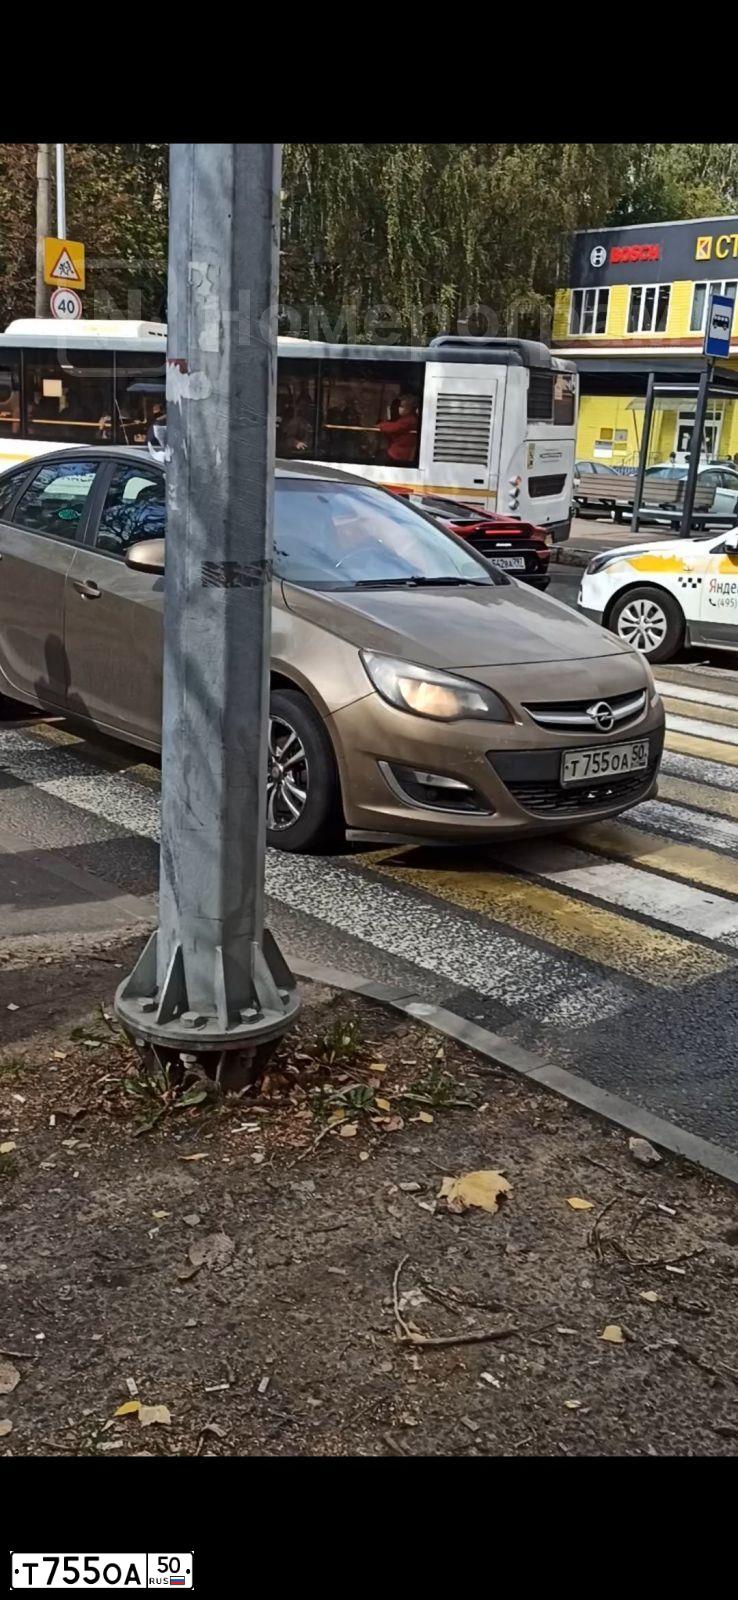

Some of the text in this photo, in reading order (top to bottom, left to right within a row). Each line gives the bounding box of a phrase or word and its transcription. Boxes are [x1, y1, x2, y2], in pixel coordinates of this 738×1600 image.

[610, 244, 660, 264] BOSCH
[58, 299, 75, 314] 40
[709, 578, 738, 594] Янде
[631, 745, 645, 761] 50
